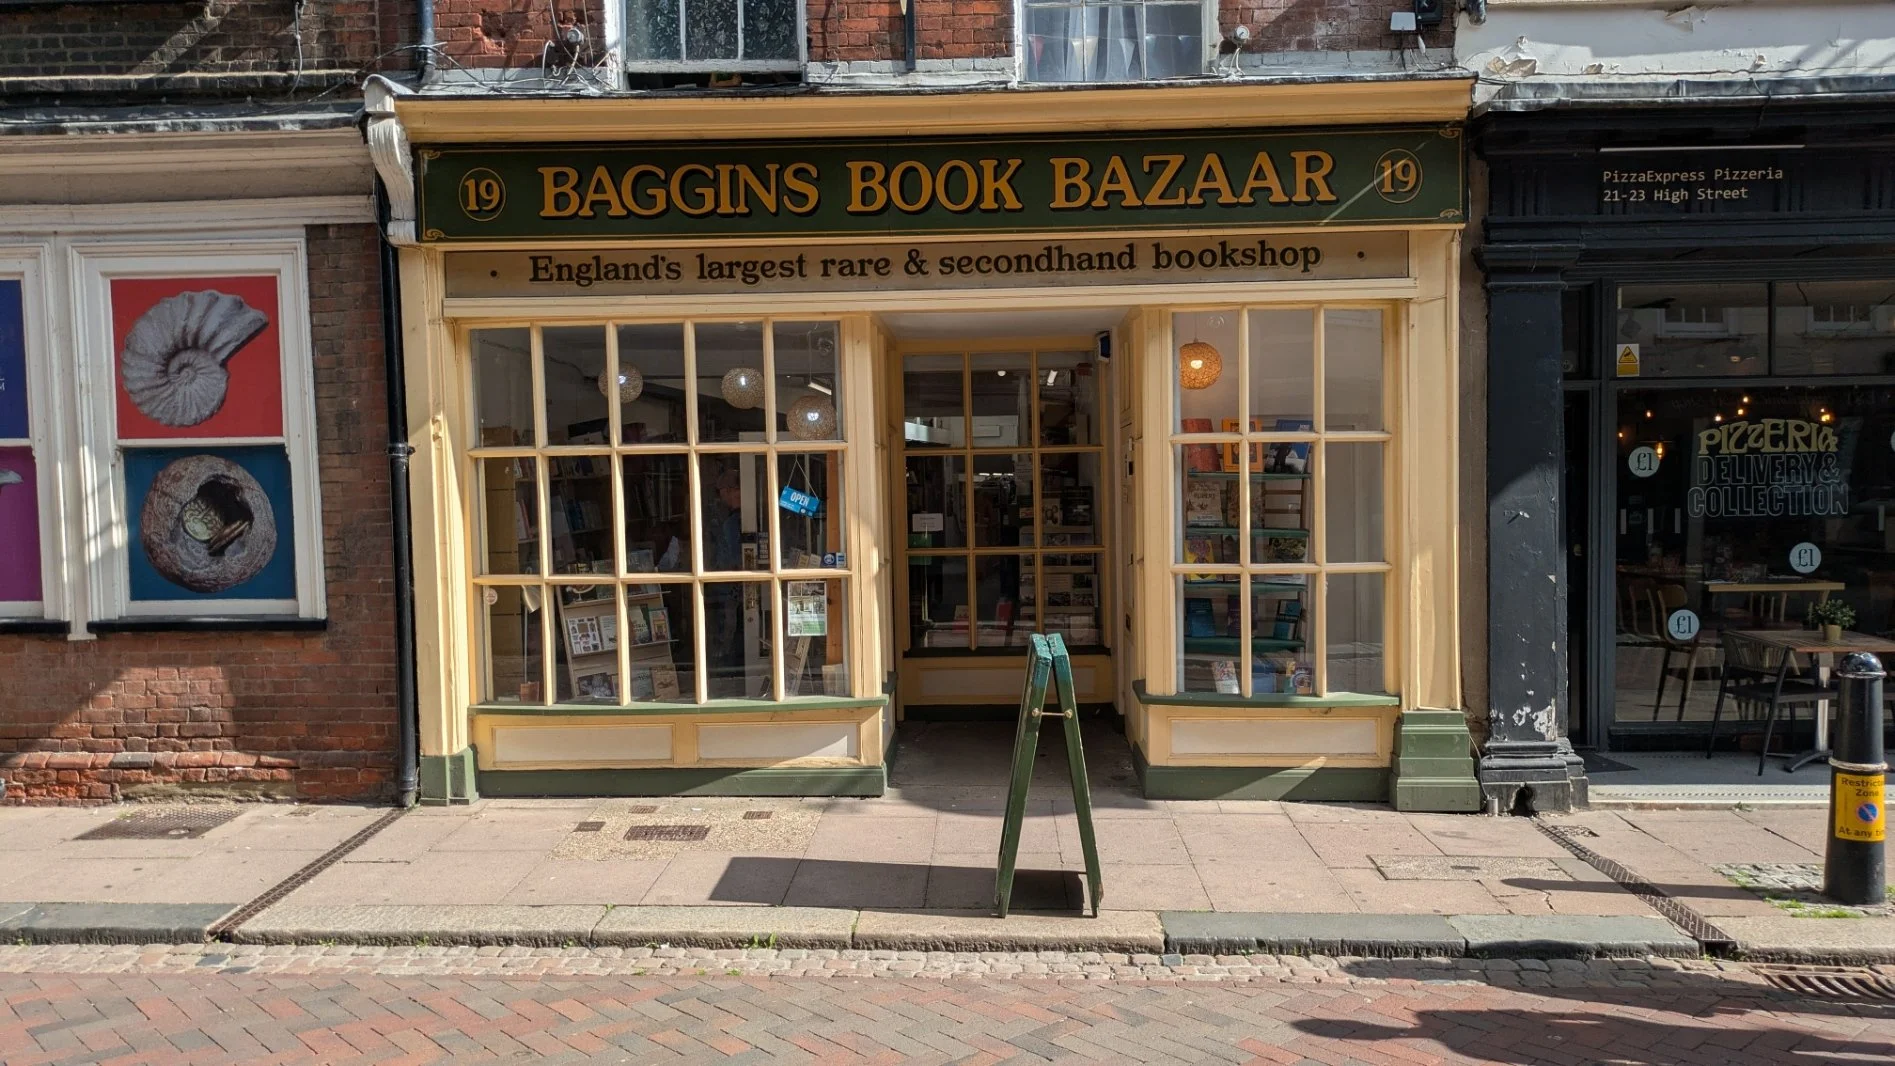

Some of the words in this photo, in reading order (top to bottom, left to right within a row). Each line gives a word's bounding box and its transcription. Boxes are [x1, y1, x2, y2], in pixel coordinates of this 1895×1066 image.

[537, 162, 821, 219] BAGGINS
[845, 156, 1024, 215] BOOK
[1049, 149, 1337, 210] BAZAAR
[1379, 158, 1418, 194] 19
[1603, 170, 1706, 184] PizzaExpress
[1714, 167, 1784, 182] Pizzeria
[464, 178, 500, 211] 19
[1603, 189, 1646, 202] 21-23
[1654, 188, 1689, 203] High
[1697, 186, 1749, 201] Street
[529, 253, 682, 288] England's
[696, 252, 808, 285] largest
[820, 256, 892, 278] rare
[903, 248, 930, 276] &
[938, 242, 1137, 276] secondhand
[1152, 239, 1323, 274] bookshop
[1697, 453, 1818, 486] DELIVERY
[1818, 452, 1841, 484] &
[790, 491, 810, 508] OPEN
[1687, 483, 1849, 518] COLLECTION
[1855, 788, 1880, 797] Zone
[1839, 826, 1850, 836] At
[1854, 829, 1872, 838] any
